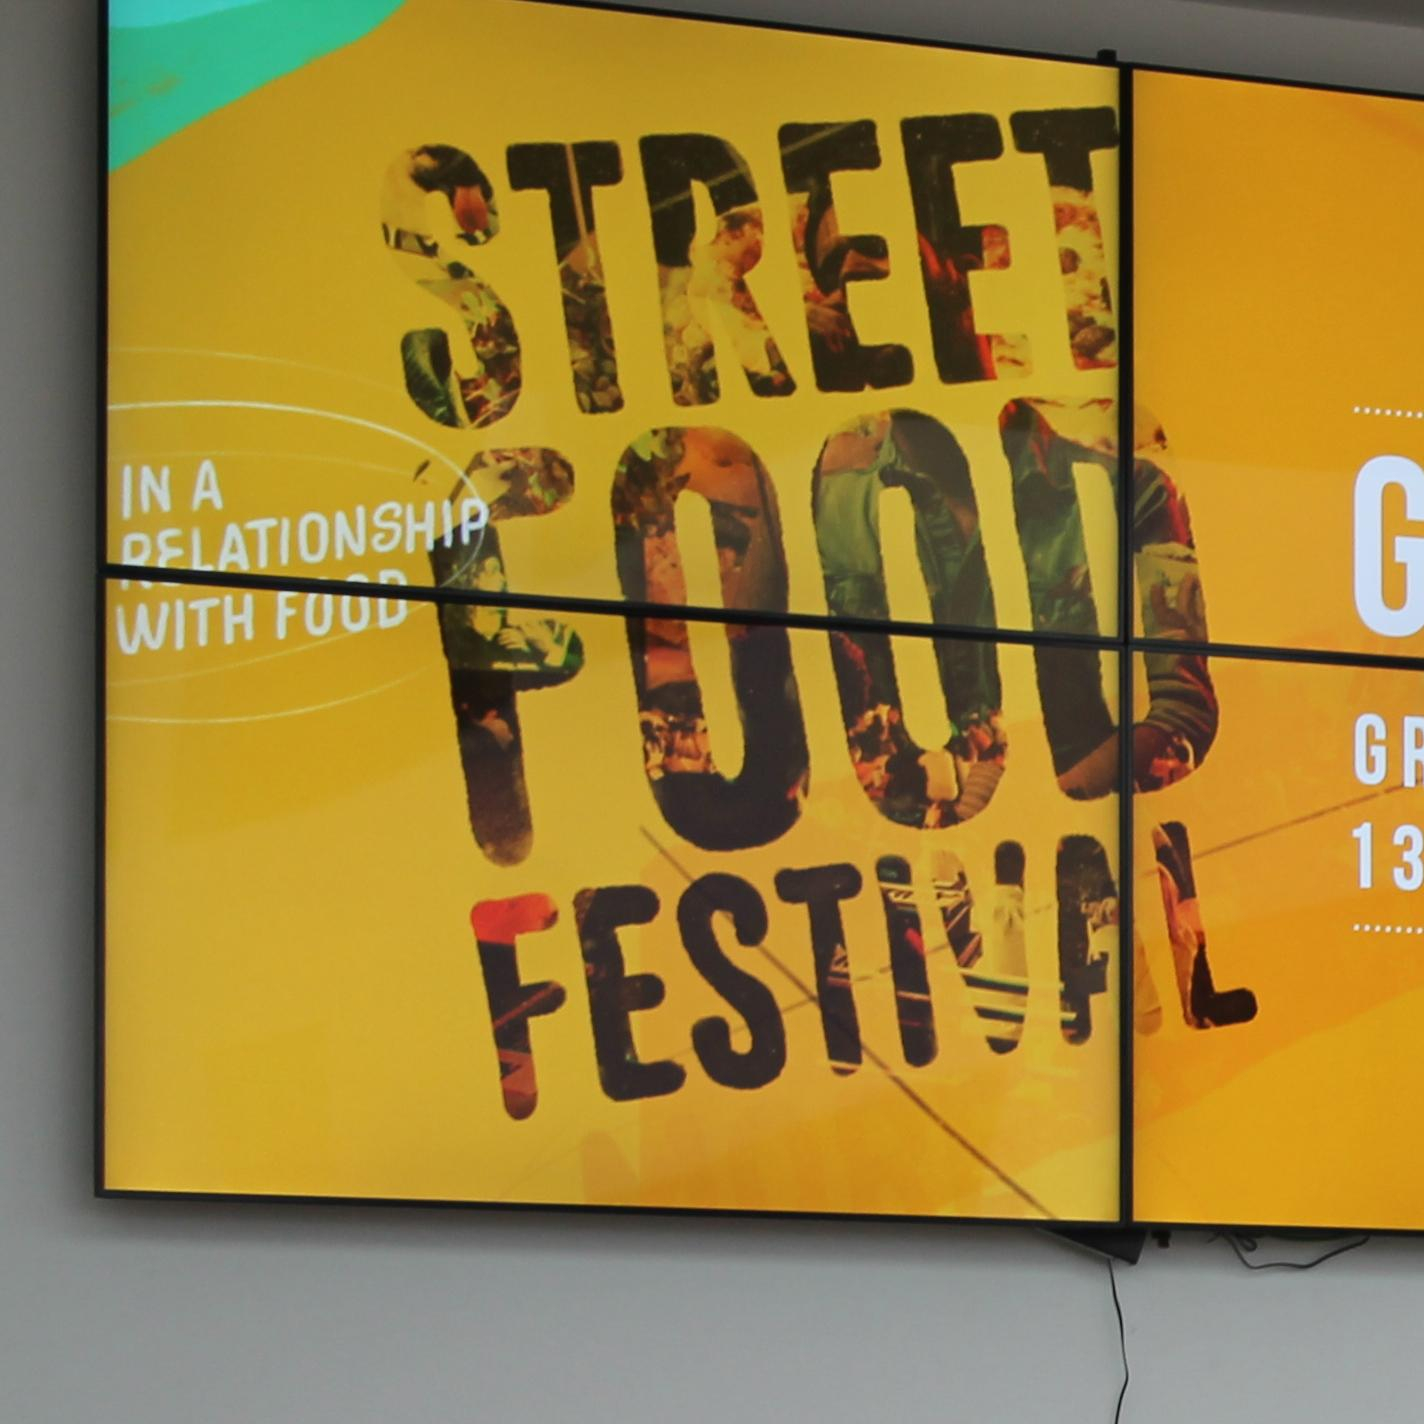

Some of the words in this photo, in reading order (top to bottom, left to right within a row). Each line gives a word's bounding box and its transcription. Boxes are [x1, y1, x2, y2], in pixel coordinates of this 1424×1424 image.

[380, 105, 1121, 430] STREET
[119, 497, 491, 592] RELATIONSHIP
[121, 464, 172, 520] IN
[192, 459, 224, 511] A
[116, 594, 255, 656] WITH
[275, 567, 409, 640] FOOD
[413, 394, 1221, 867] FOOD
[470, 818, 1260, 1121] FESTIVAL
